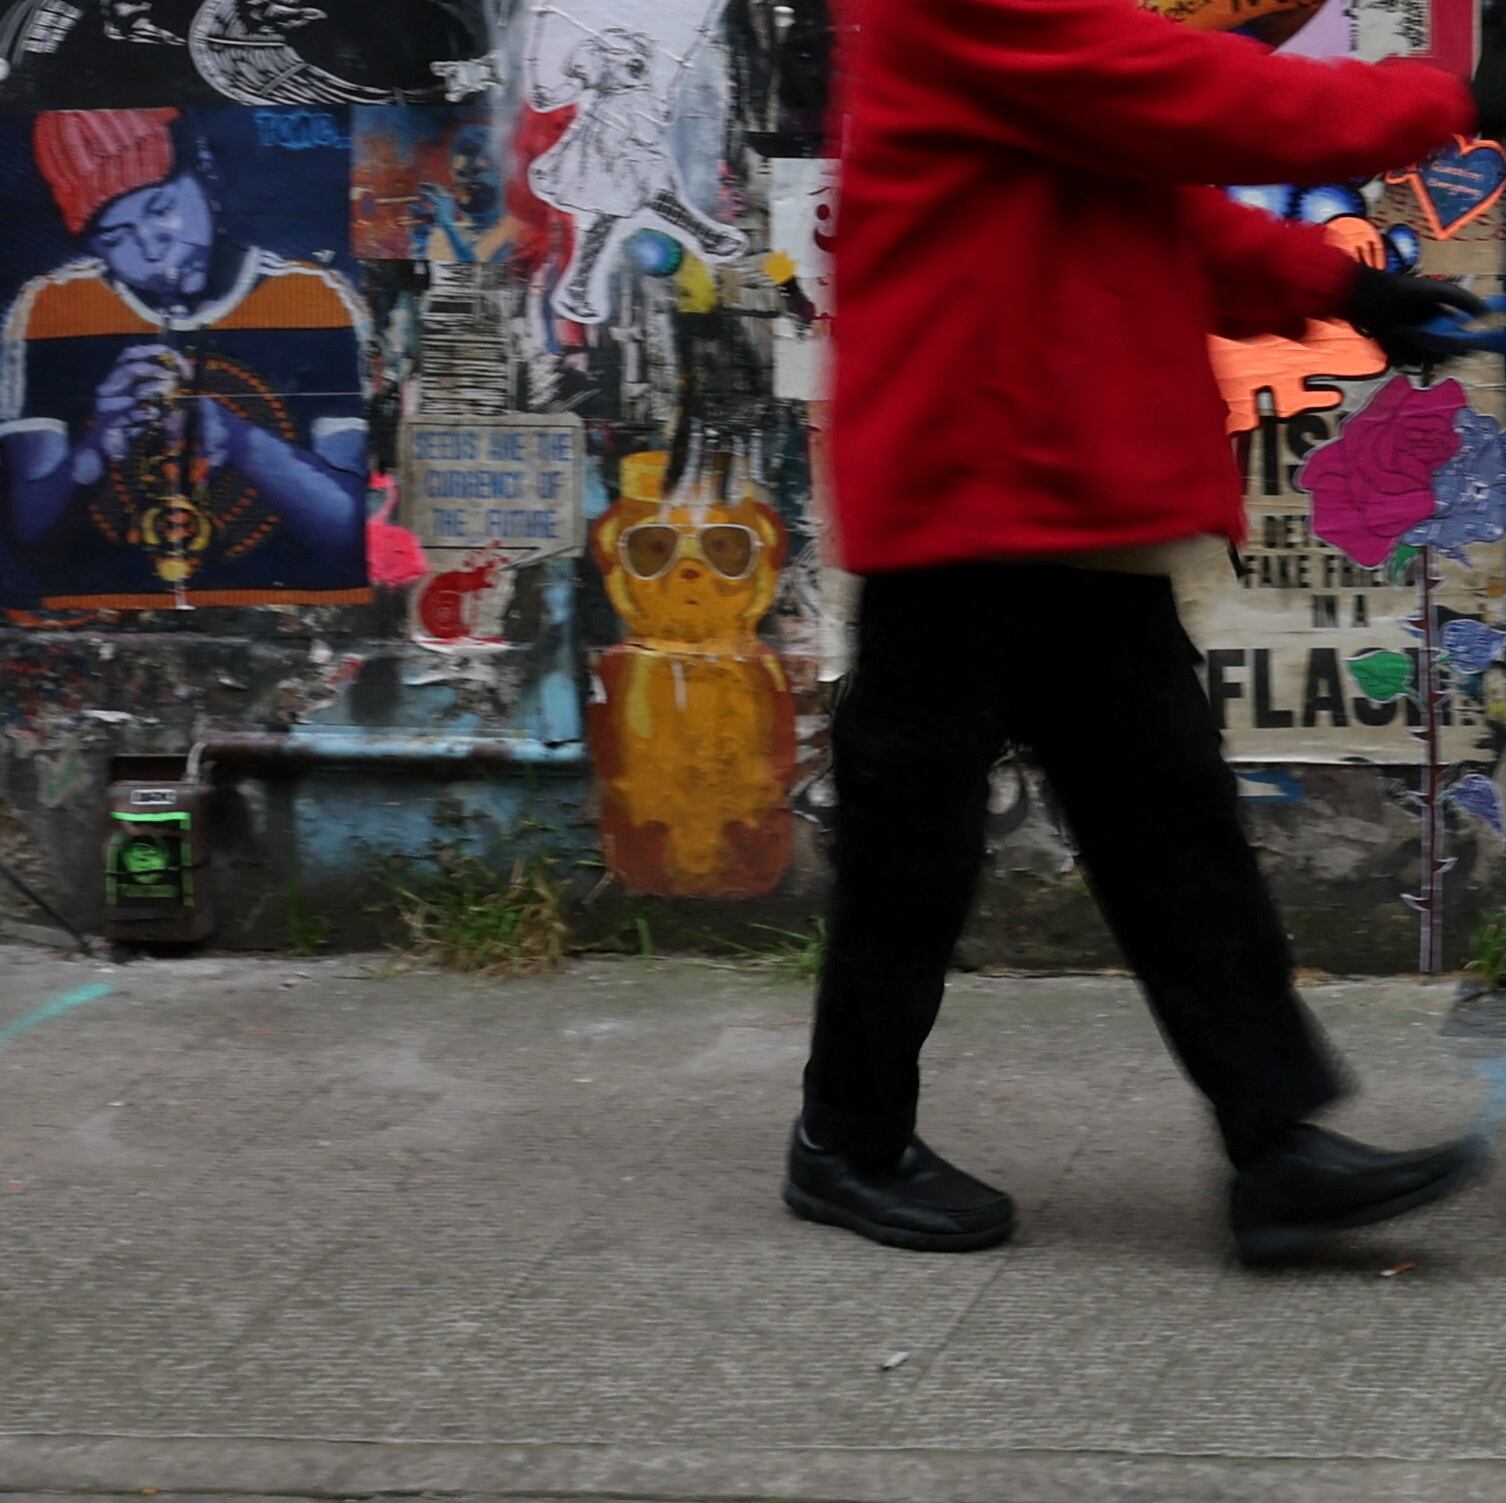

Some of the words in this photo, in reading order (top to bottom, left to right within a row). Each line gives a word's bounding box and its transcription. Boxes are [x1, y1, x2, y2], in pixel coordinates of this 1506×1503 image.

[414, 430, 477, 461] SEEDS
[489, 431, 526, 462] ARE
[536, 432, 572, 462] THE
[424, 469, 523, 500] CURRENCY
[536, 471, 563, 500] OF
[432, 507, 467, 538] THE
[485, 508, 560, 539] FUTURE
[1311, 594, 1341, 629] IN
[1351, 594, 1372, 629] A
